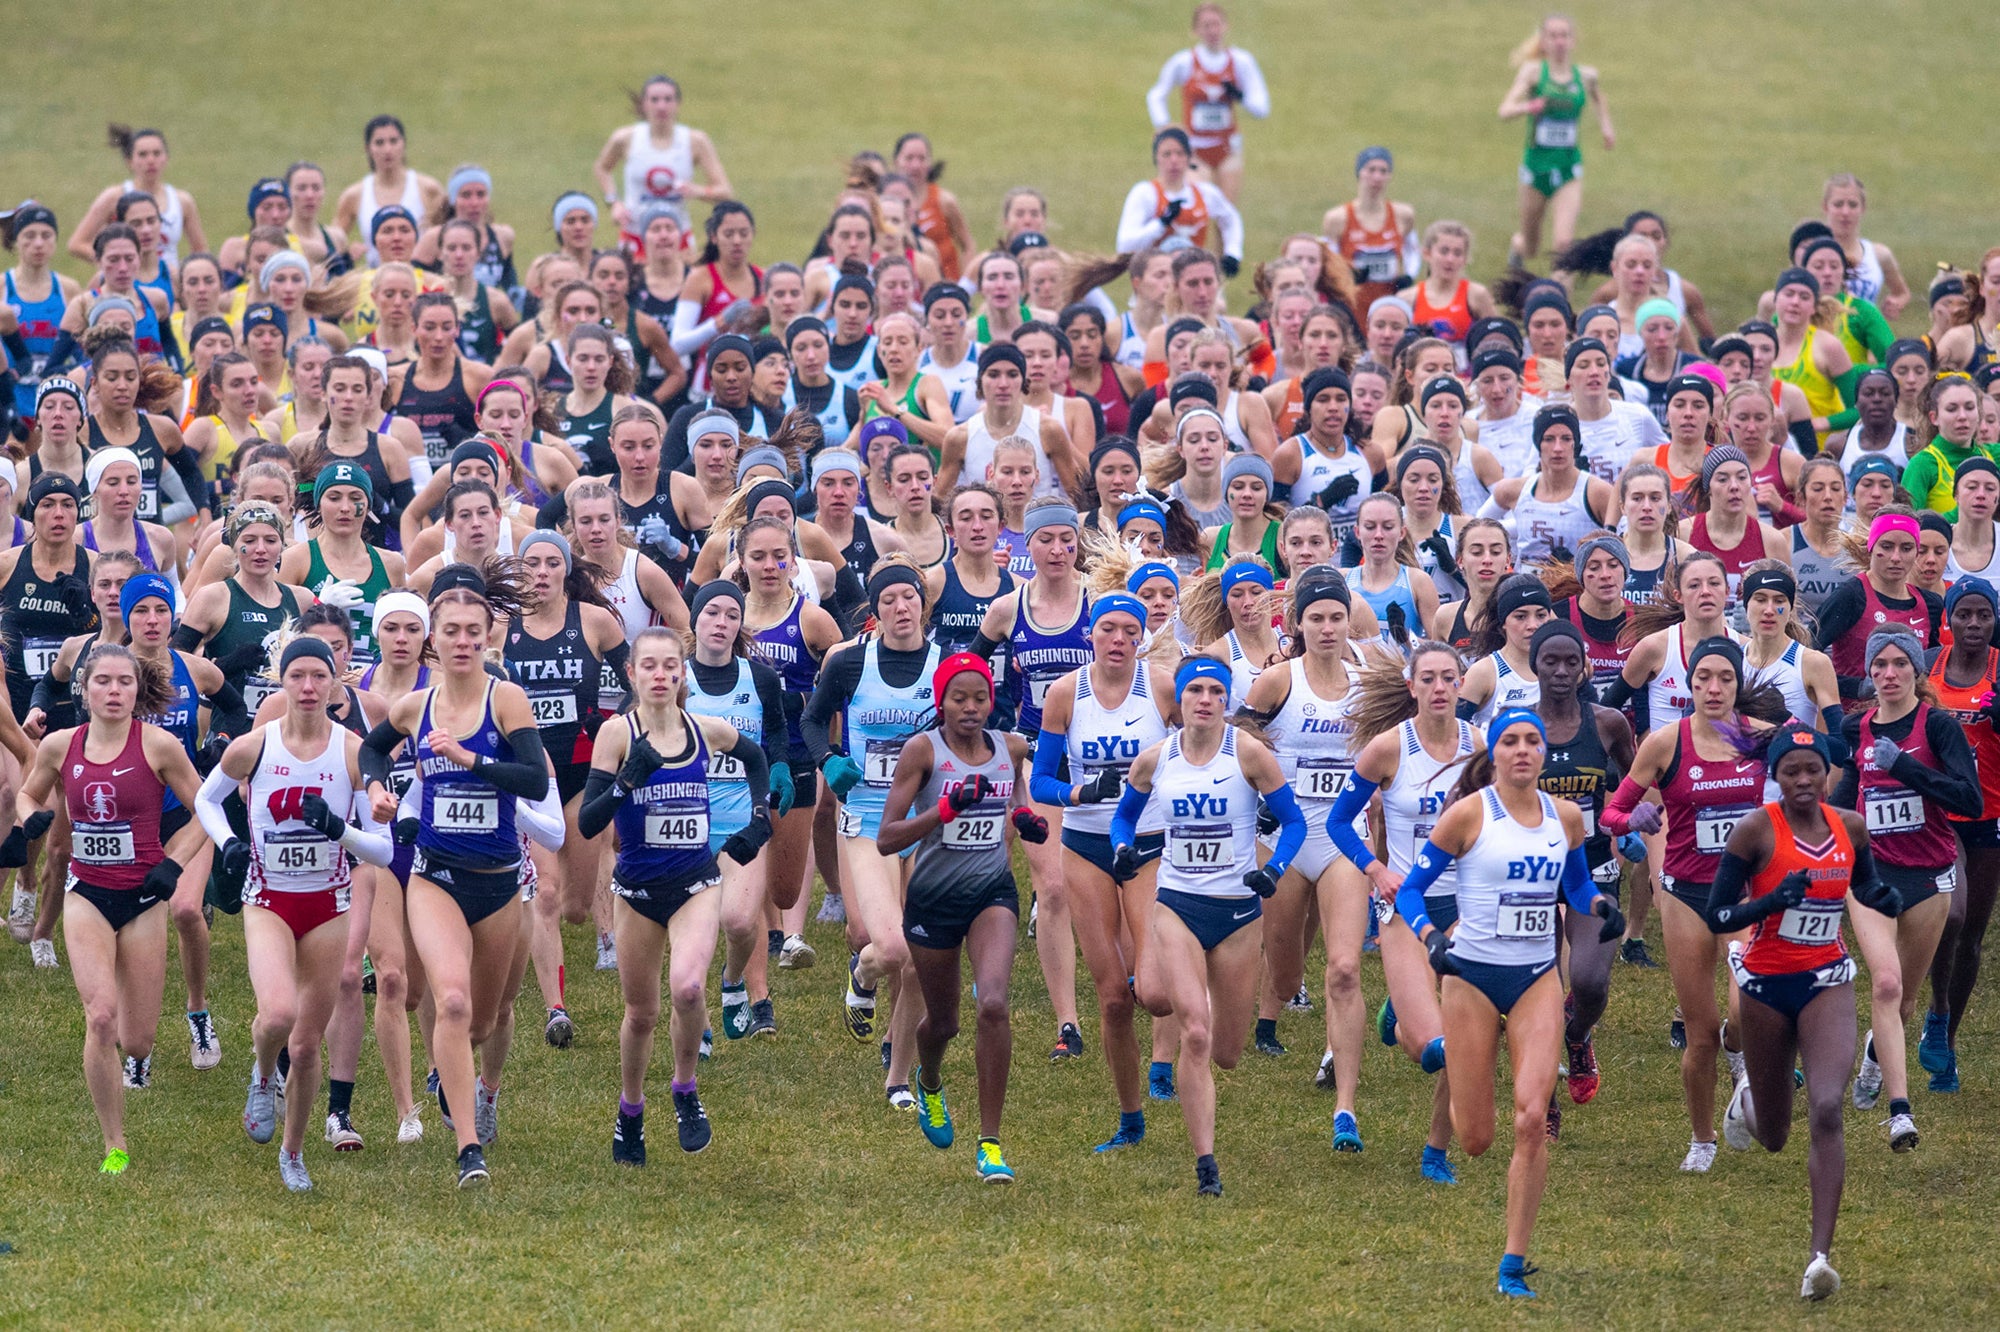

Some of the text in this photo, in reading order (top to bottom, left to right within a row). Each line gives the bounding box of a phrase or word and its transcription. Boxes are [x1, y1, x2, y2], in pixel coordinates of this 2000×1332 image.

[426, 441, 447, 460] 85
[335, 464, 353, 480] E
[19, 597, 70, 615] COLORA
[942, 613, 982, 627] MONTAN
[1017, 647, 1095, 668] WASHINGTON
[514, 658, 584, 681] TAH
[599, 668, 621, 690] 58
[1082, 735, 1140, 761] BYU
[707, 754, 737, 775] 75
[879, 756, 899, 778] 17
[1310, 772, 1346, 794] 187
[1540, 775, 1598, 792] ICHITA
[1692, 777, 1755, 792] ARKANSAS
[445, 802, 485, 824] 444
[1172, 793, 1228, 819] BYU
[1875, 801, 1912, 825] 114
[659, 818, 698, 840] 446
[957, 820, 994, 841] 242
[1710, 821, 1735, 843] 12
[83, 836, 122, 856] 383
[278, 846, 318, 868] 454
[1183, 842, 1222, 863] 147
[1507, 855, 1562, 883] BYU
[1513, 909, 1549, 932] 153
[1797, 915, 1831, 937] 121
